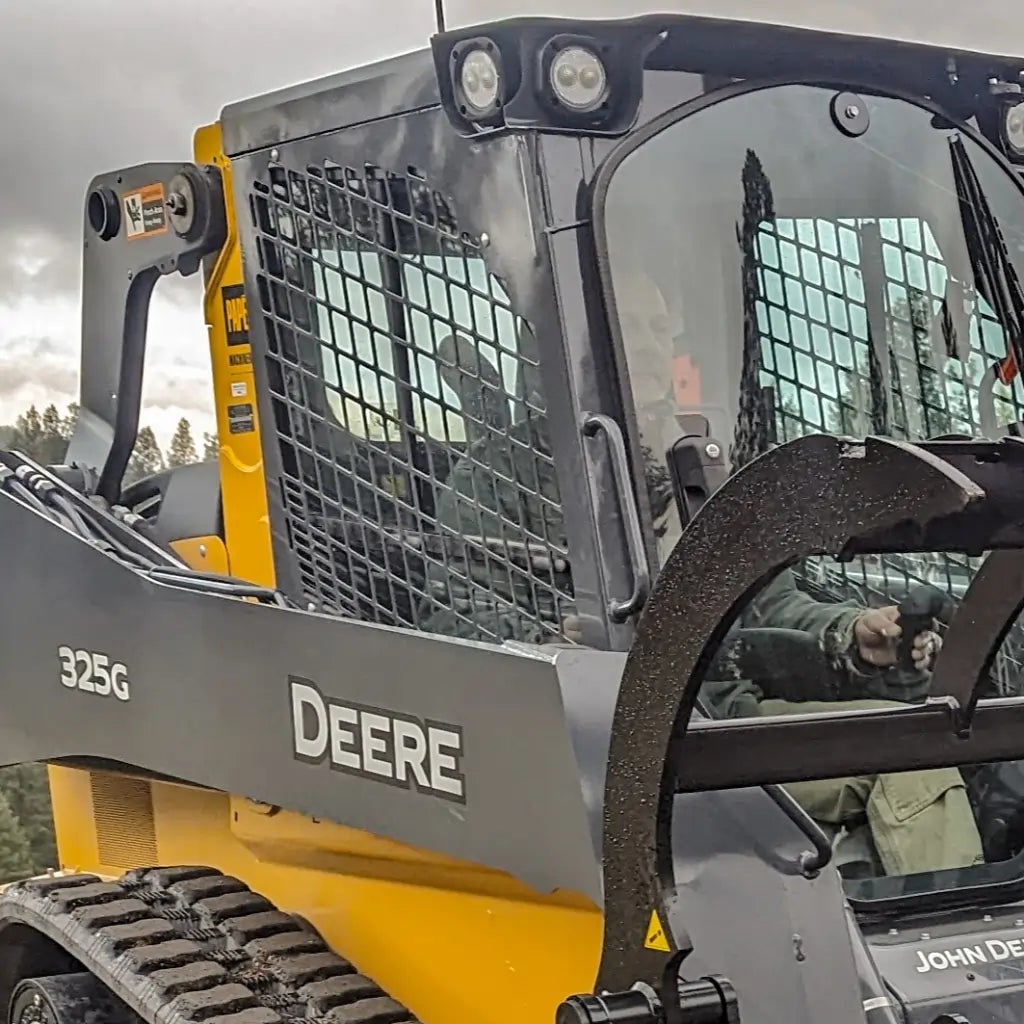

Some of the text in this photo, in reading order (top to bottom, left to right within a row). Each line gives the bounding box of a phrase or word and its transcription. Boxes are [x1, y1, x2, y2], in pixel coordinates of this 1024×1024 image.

[59, 646, 130, 701] 325G
[291, 681, 464, 797] DEERE
[915, 945, 988, 973] JOHN
